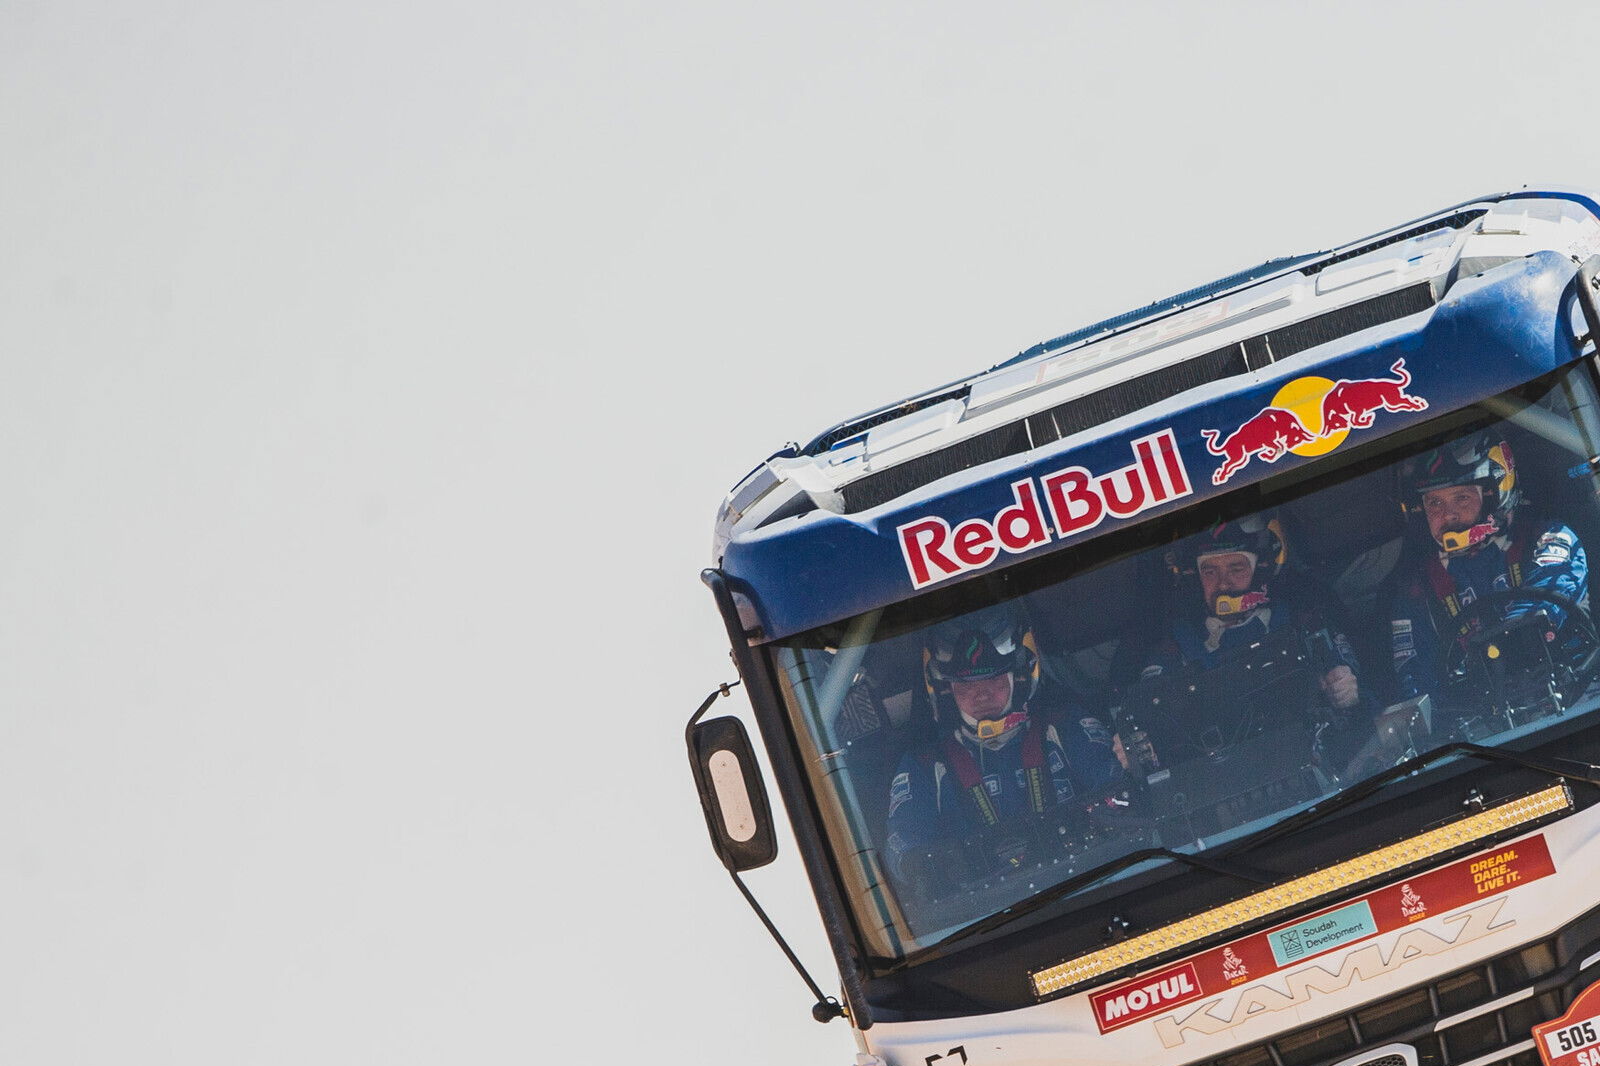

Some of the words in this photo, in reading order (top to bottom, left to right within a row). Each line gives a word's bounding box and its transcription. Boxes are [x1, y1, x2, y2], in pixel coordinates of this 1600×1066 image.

[897, 477, 1051, 589] Red
[1042, 427, 1193, 539] Bull
[1470, 850, 1518, 874] DREAM.
[1474, 864, 1511, 884] DARE.
[1477, 876, 1505, 894] LIVE
[1506, 870, 1521, 884] IT.
[1302, 920, 1337, 937] Soudah
[1305, 923, 1364, 949] Development
[1152, 895, 1516, 1049] KAMAZ
[1104, 973, 1194, 1022] MOTUL
[1558, 1021, 1598, 1052] 505
